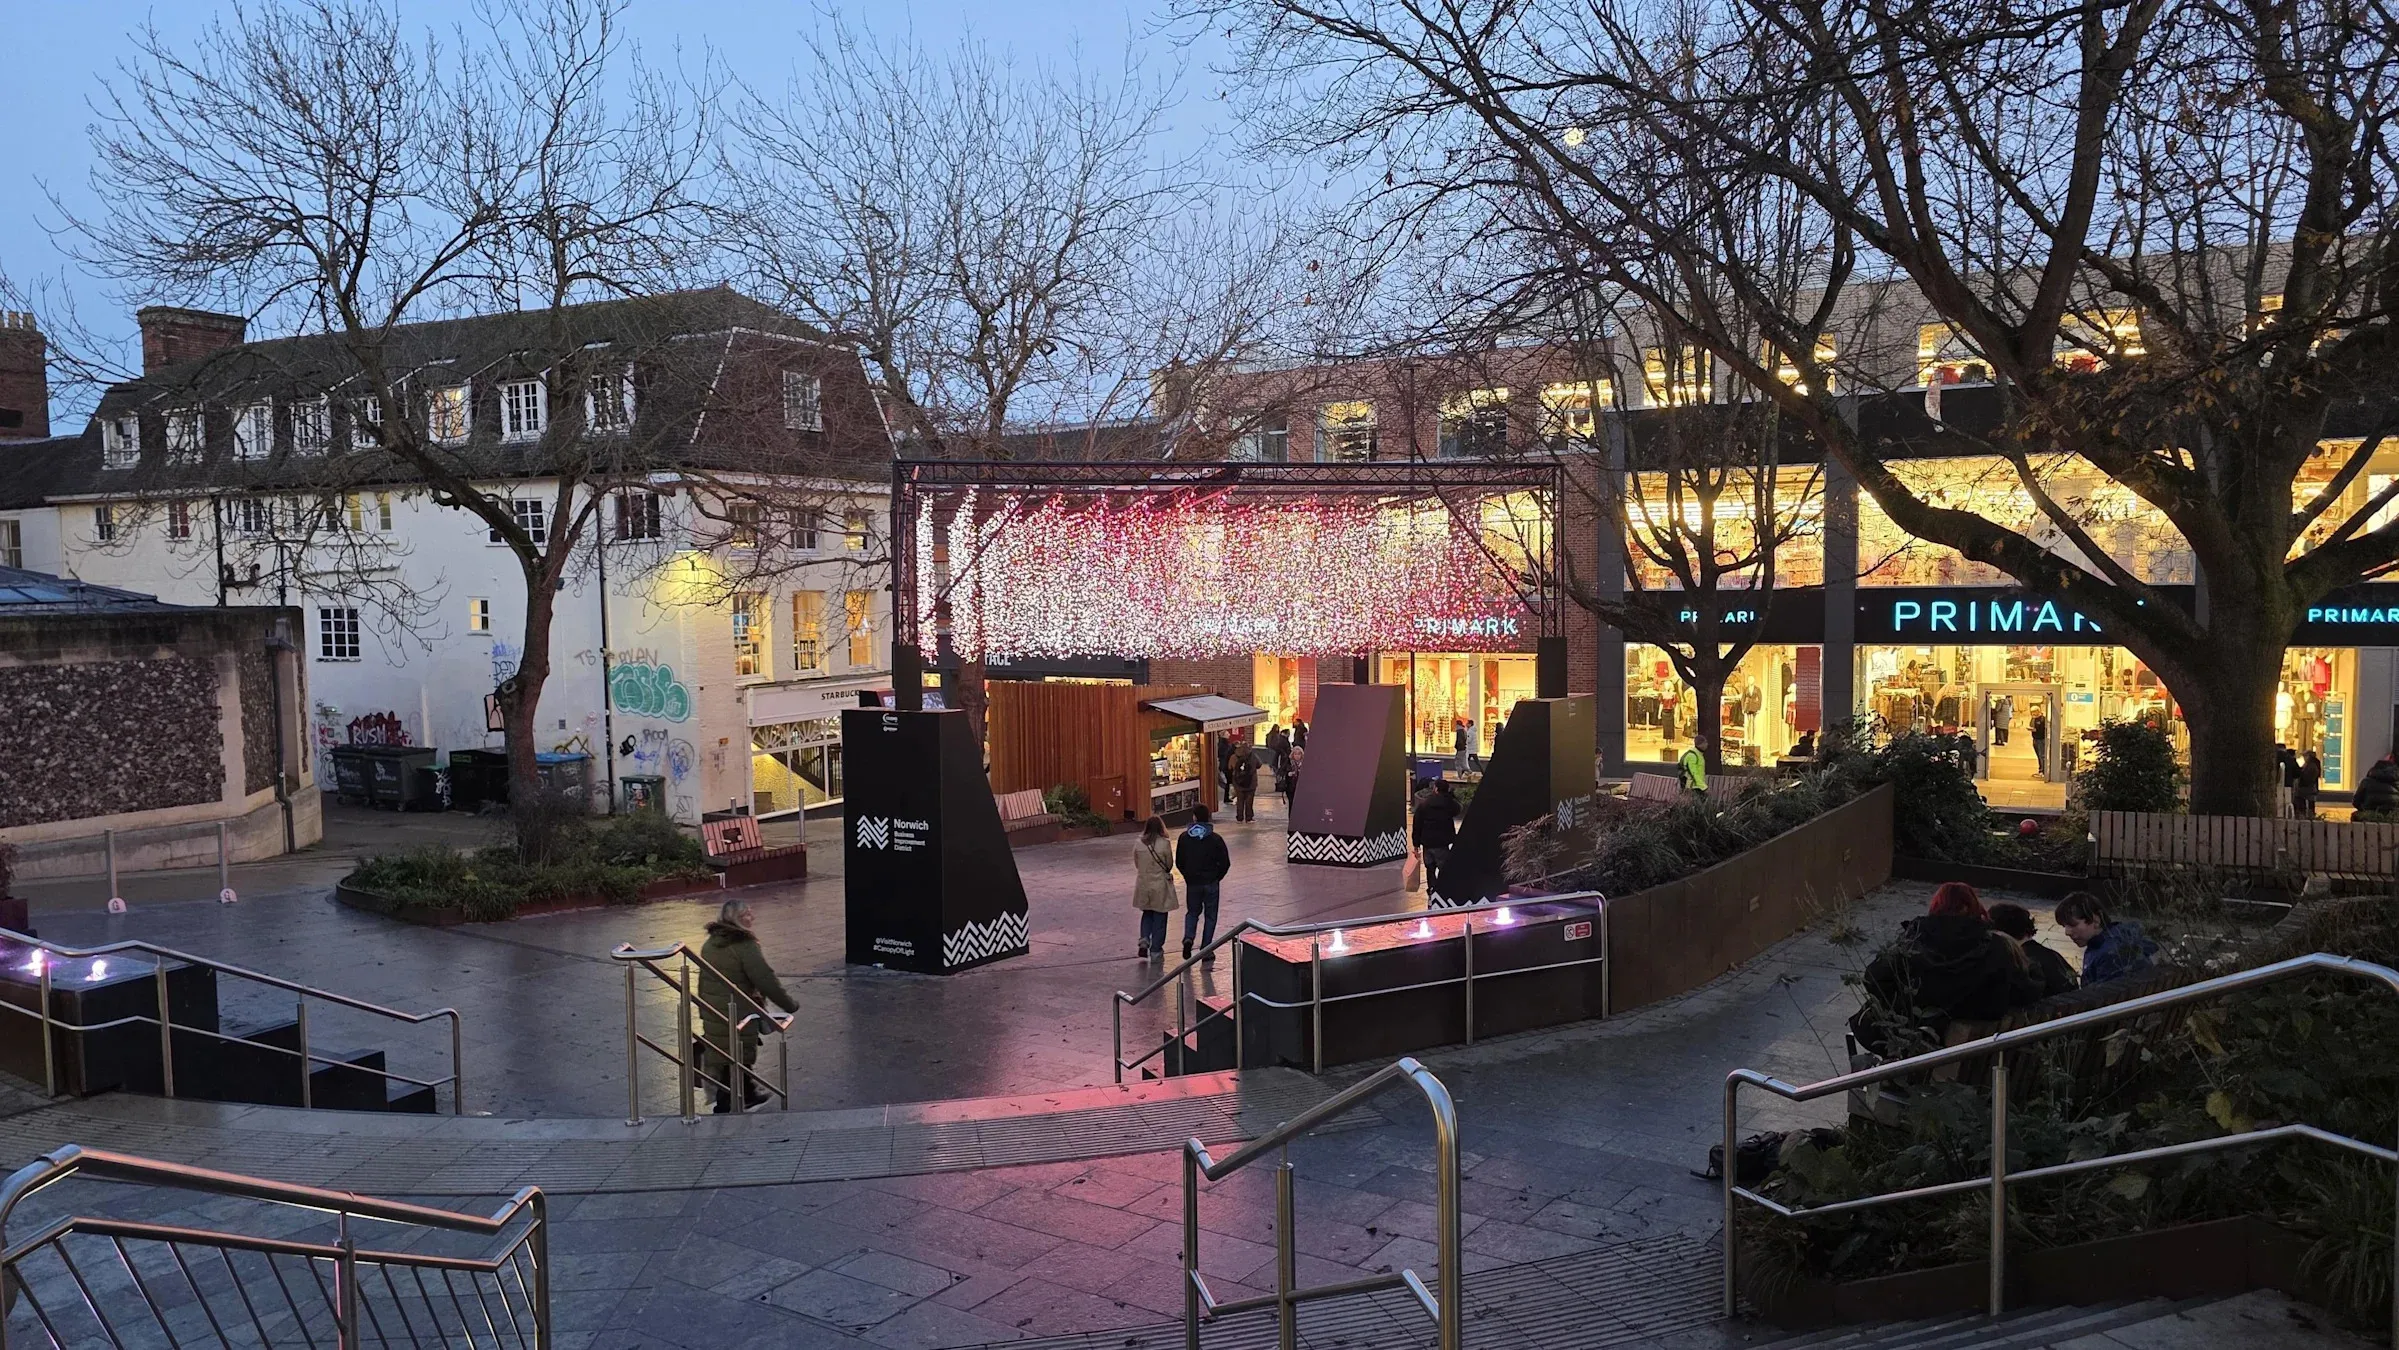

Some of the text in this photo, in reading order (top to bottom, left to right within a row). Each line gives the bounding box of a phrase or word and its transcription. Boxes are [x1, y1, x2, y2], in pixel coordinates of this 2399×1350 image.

[1894, 600, 2103, 632] PRIMAR
[821, 689, 863, 700] STARBUCK
[1256, 696, 1279, 704] FULL
[353, 724, 386, 745] RUSH
[893, 818, 929, 831] Norwich
